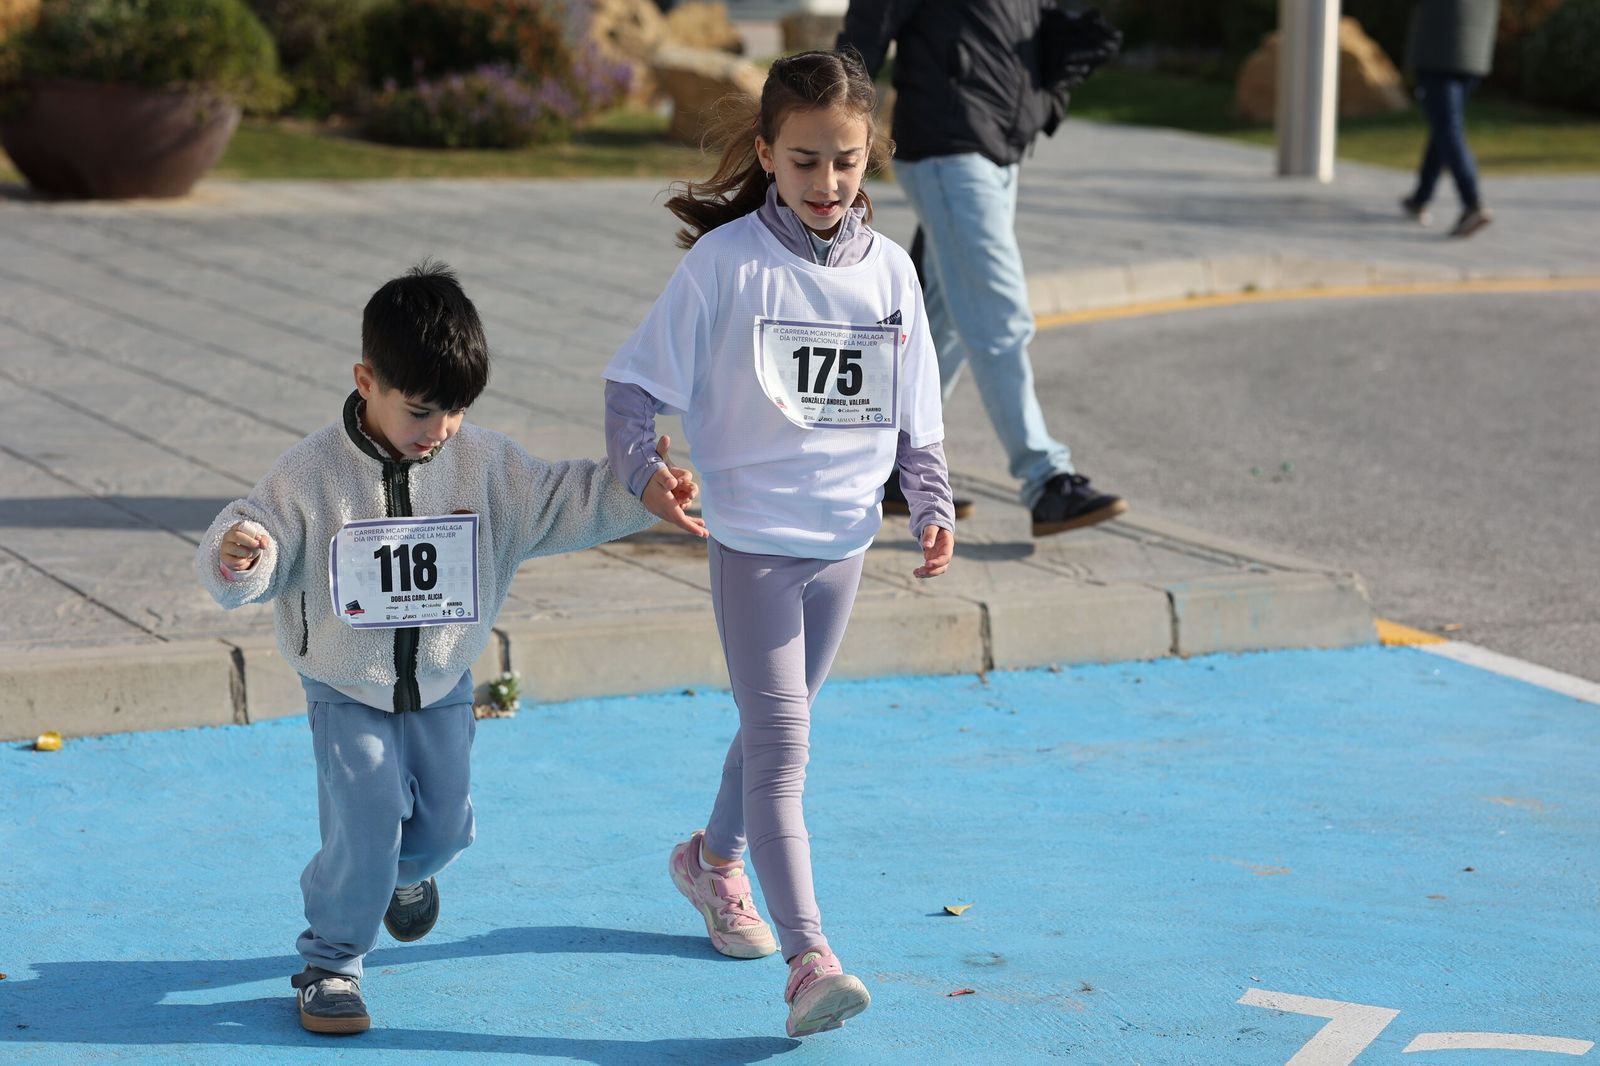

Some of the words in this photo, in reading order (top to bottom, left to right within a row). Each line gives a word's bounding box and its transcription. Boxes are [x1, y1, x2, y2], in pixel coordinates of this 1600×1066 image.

[792, 336, 838, 344] INTERNACIONAL
[793, 346, 863, 396] 175
[801, 396, 825, 404] GONZÁLEZ
[374, 543, 437, 593] 118
